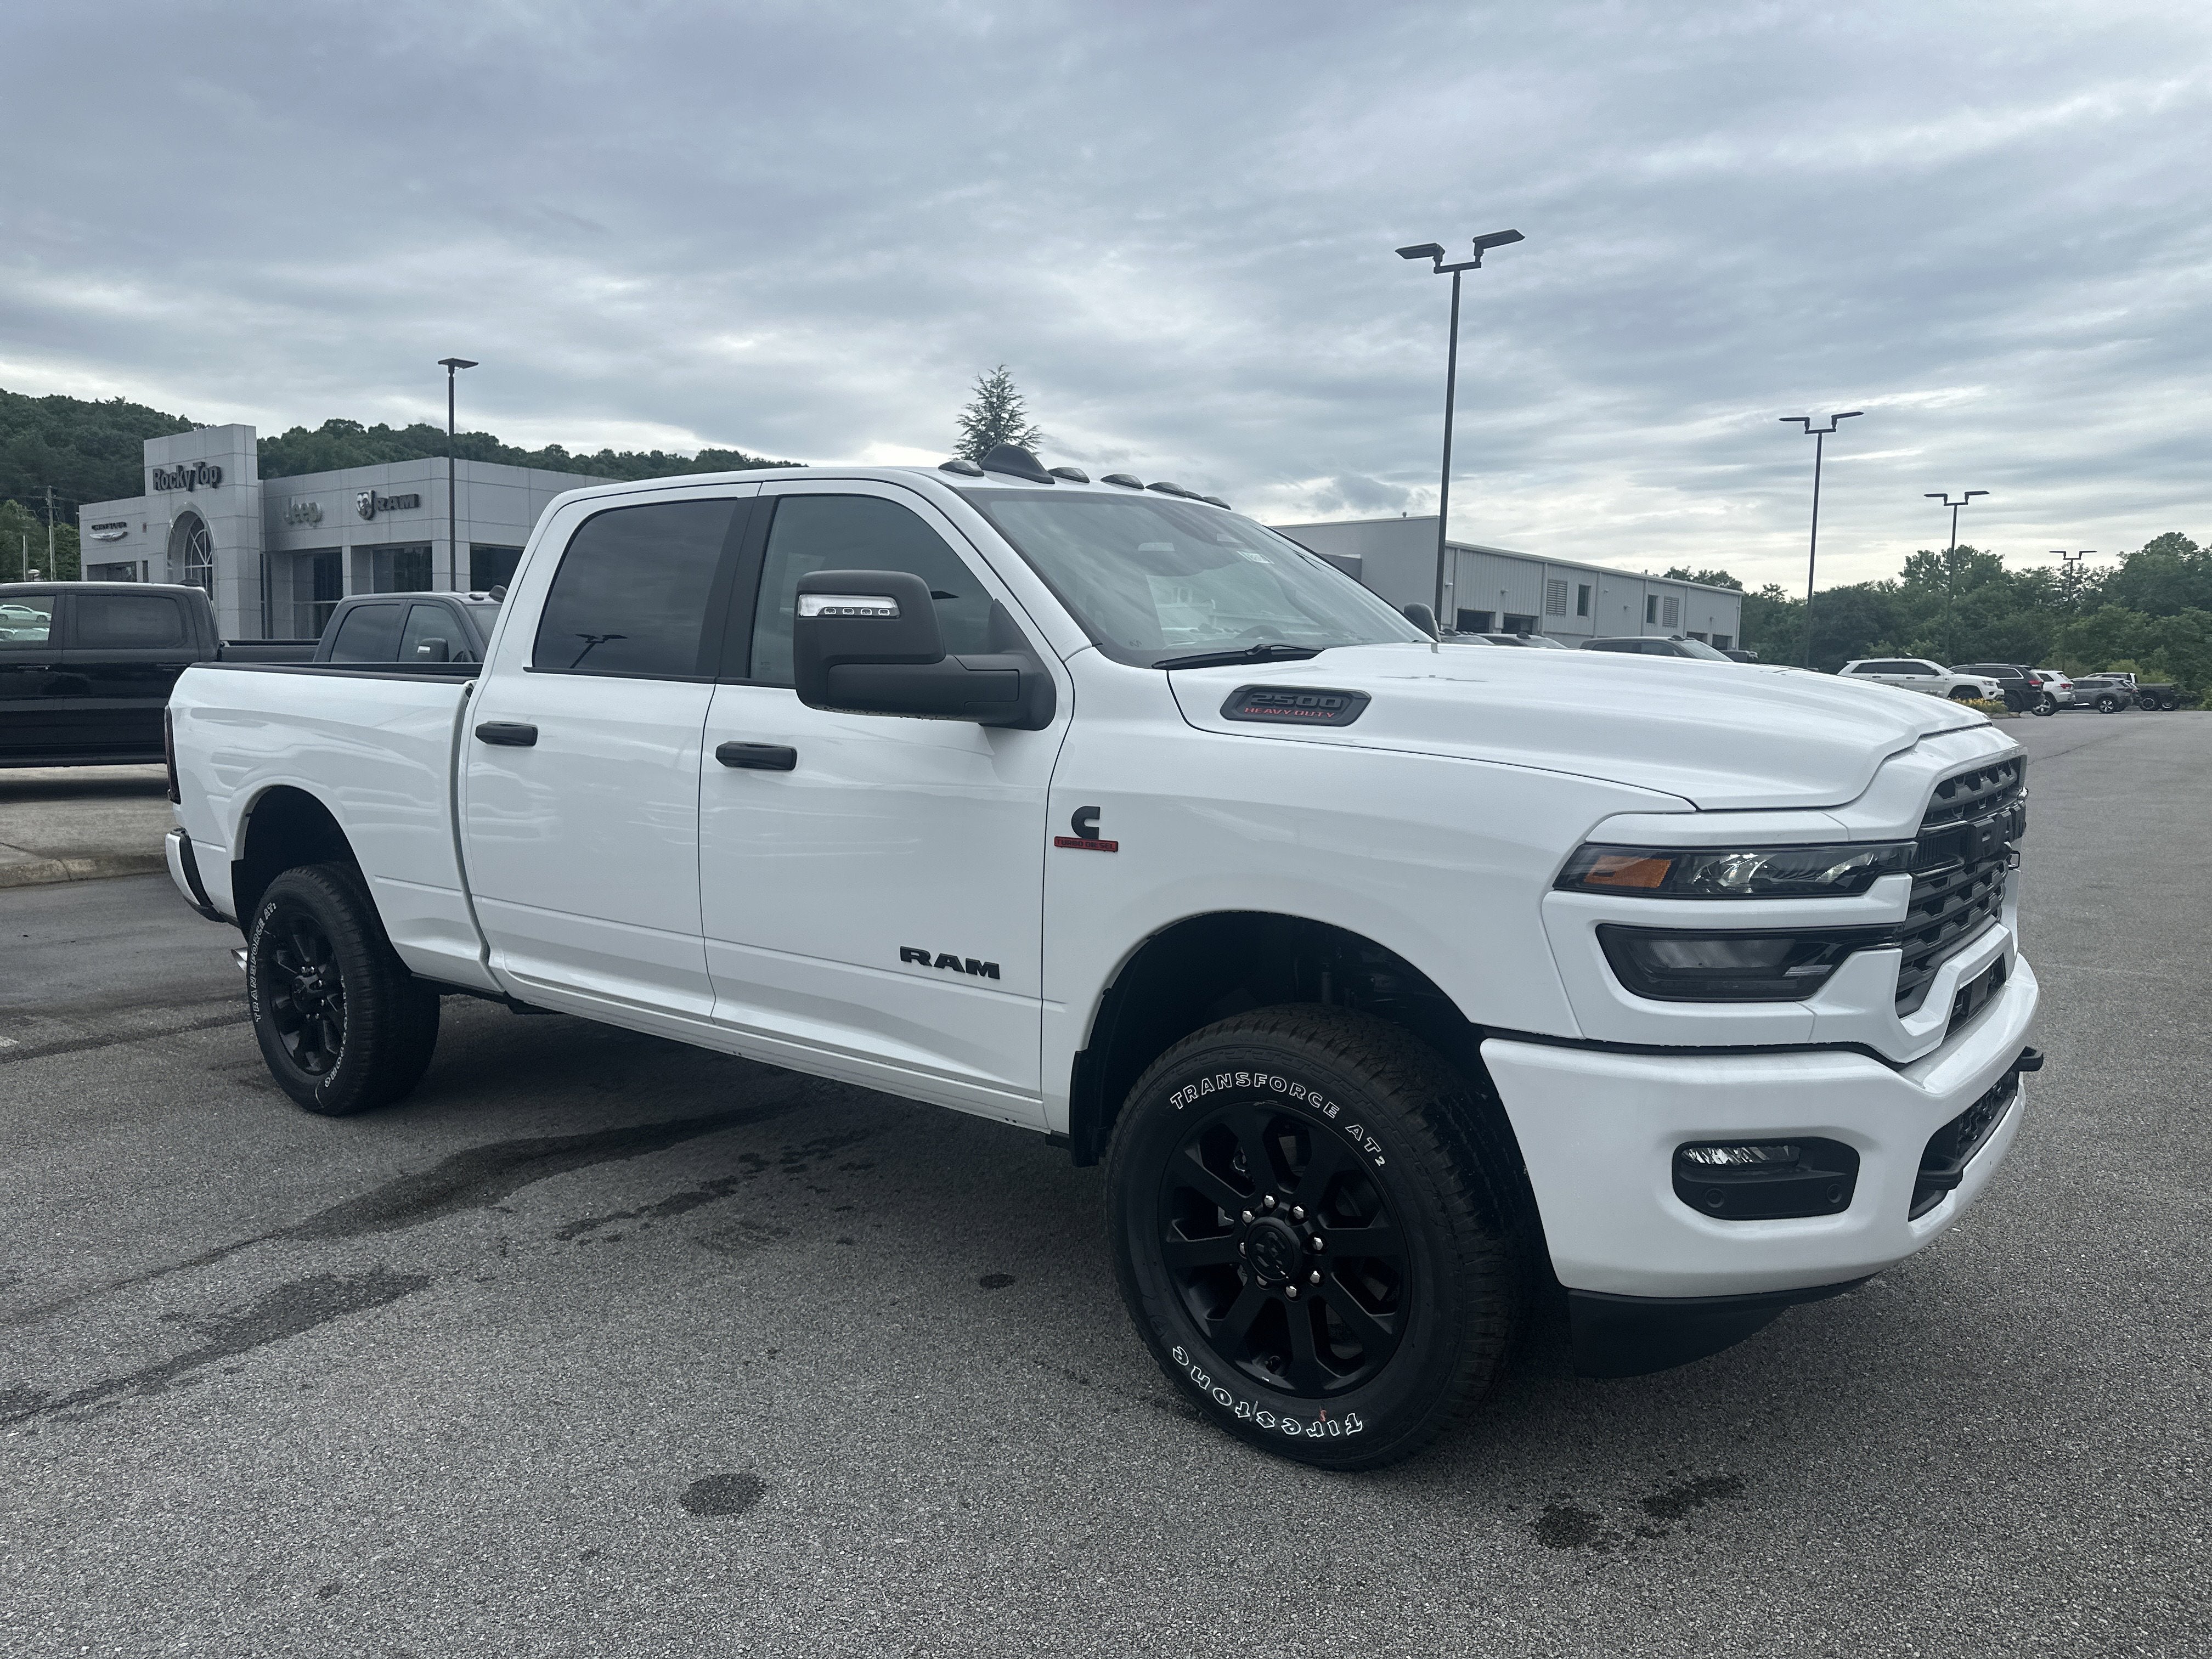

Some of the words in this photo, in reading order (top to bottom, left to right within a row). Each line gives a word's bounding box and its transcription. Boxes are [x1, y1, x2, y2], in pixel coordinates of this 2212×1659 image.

[153, 465, 194, 492] Rocky
[193, 461, 222, 489] Top
[285, 496, 323, 528] Jeep
[374, 493, 420, 512] RAM
[1244, 707, 1290, 715] HEAVY
[1250, 693, 1343, 710] 2500
[1057, 838, 1084, 847] TURBO
[1085, 841, 1116, 850] DIESEL
[900, 945, 1000, 979] RAM
[1170, 1071, 1340, 1119] TRANSFORCE
